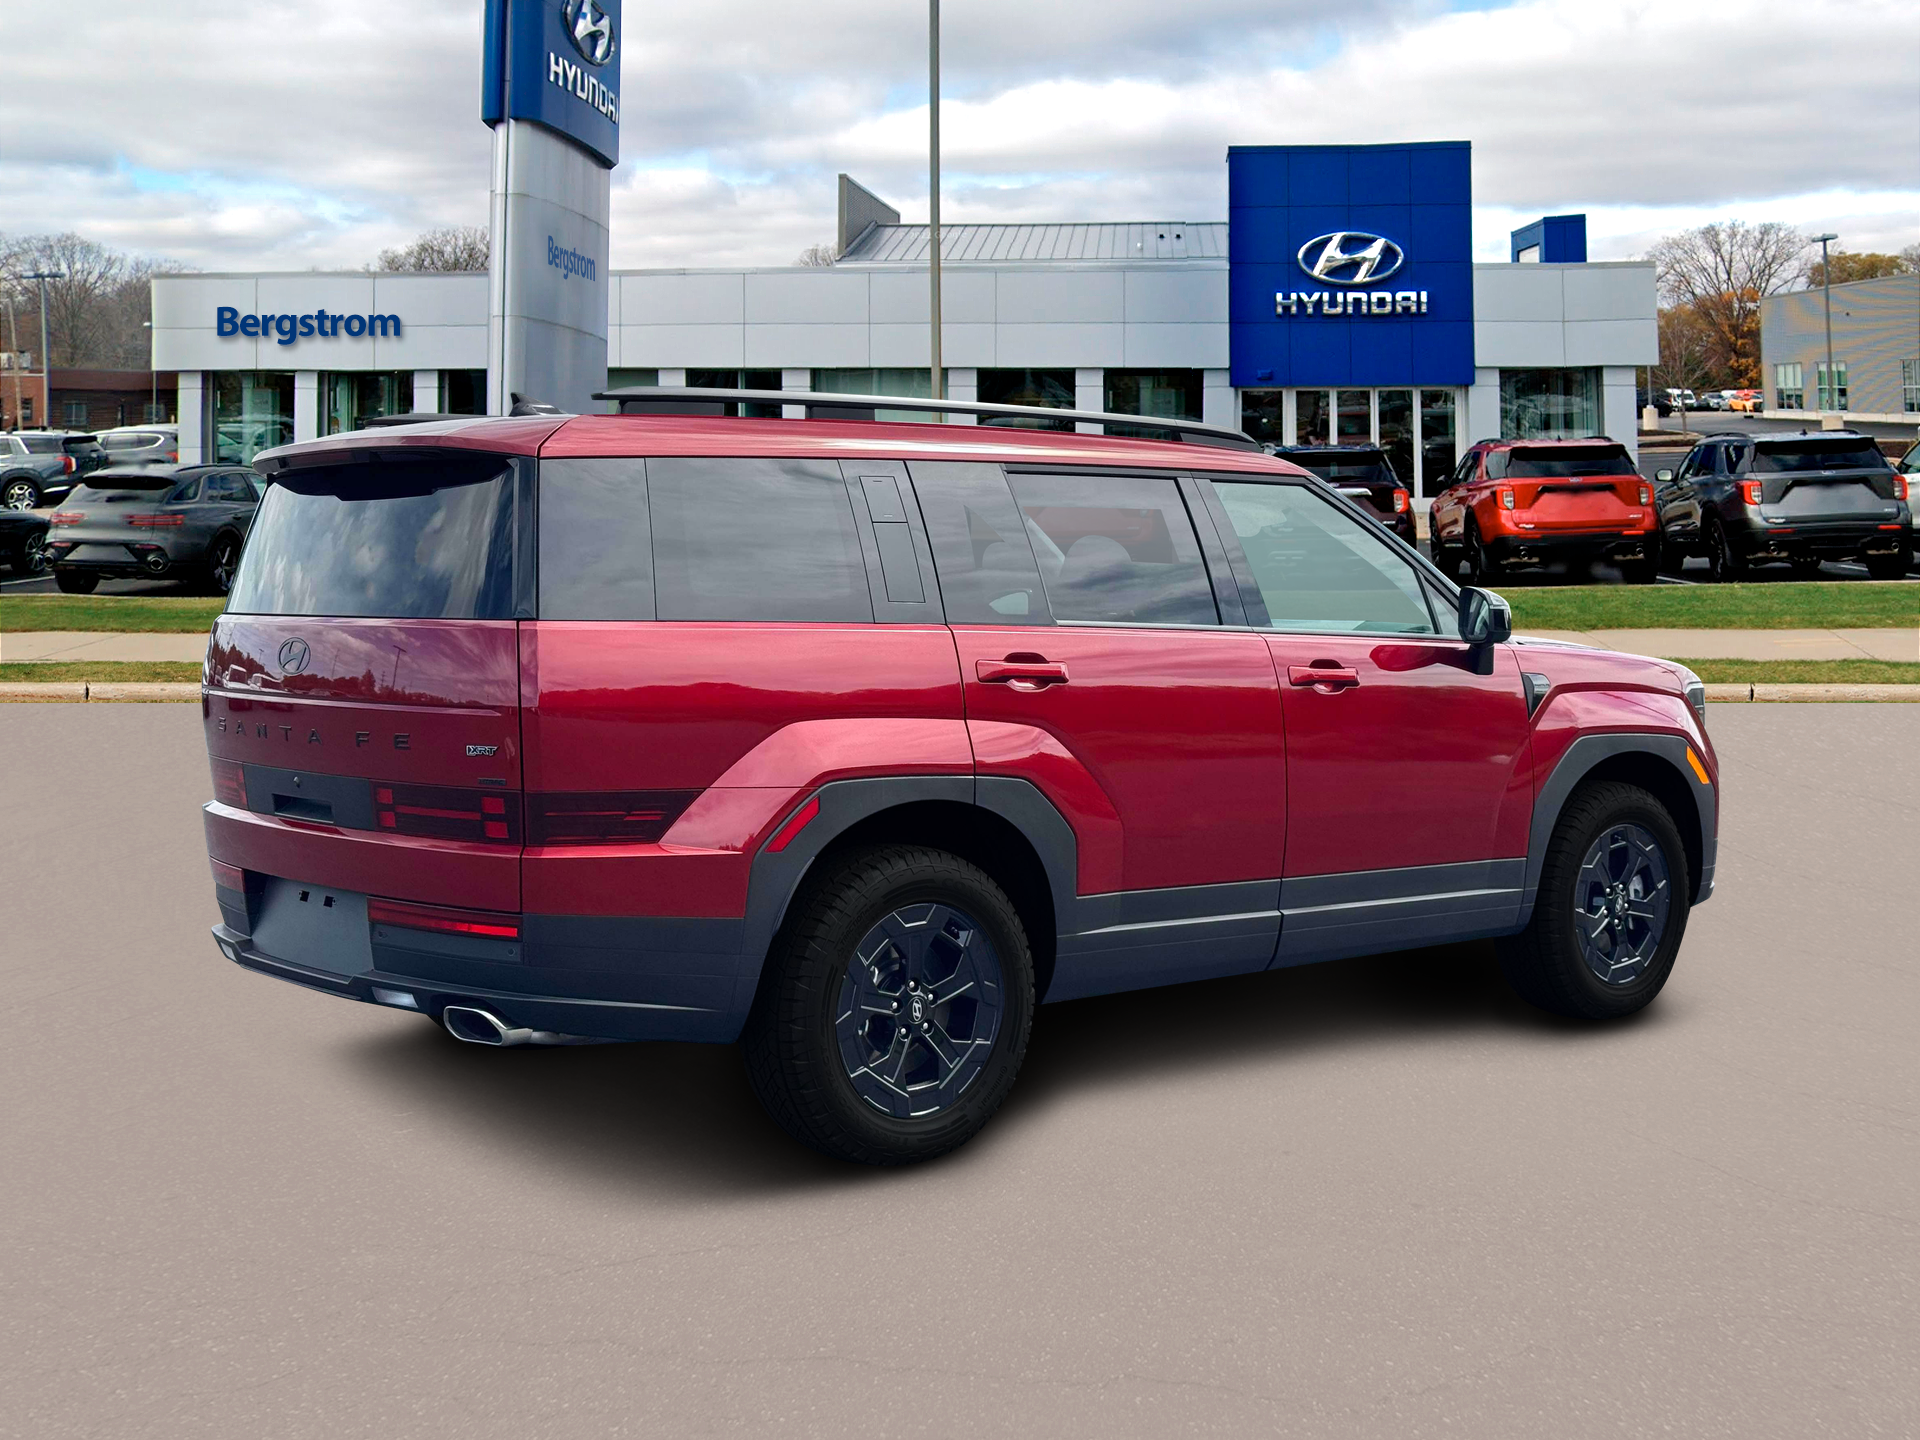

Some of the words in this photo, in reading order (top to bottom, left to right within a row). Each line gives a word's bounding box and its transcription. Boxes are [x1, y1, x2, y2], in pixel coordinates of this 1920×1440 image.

[549, 52, 619, 125] HYUNDAI
[547, 235, 596, 282] Bergstrom
[1275, 290, 1428, 315] HYUNDAI
[217, 306, 401, 345] Bergstrom
[217, 716, 322, 746] SANTA
[355, 731, 411, 750] FE
[466, 744, 499, 757] XRT
